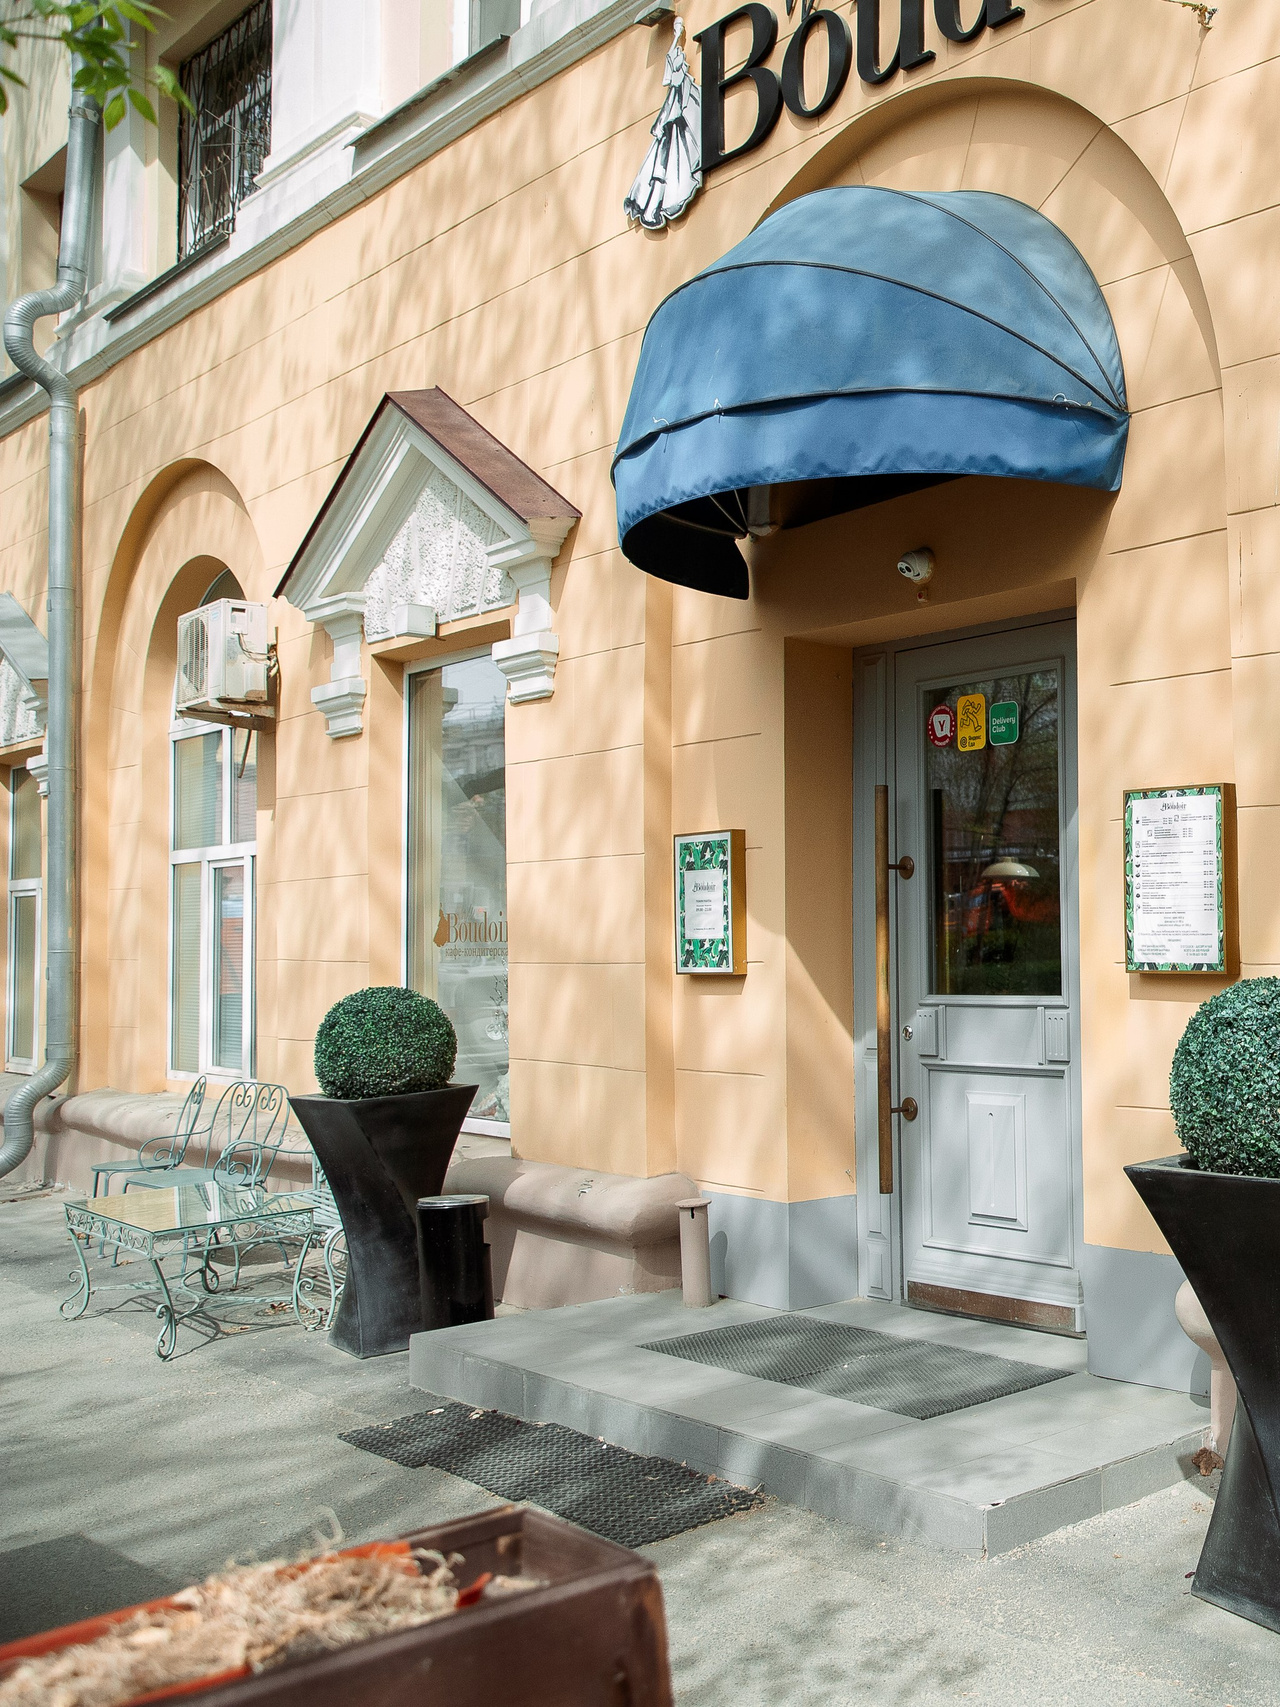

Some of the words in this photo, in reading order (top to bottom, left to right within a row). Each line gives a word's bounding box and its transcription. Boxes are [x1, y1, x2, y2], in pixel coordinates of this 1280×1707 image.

[938, 720, 946, 732] Y
[992, 716, 1016, 726] Delivery
[992, 725, 1006, 733] Club
